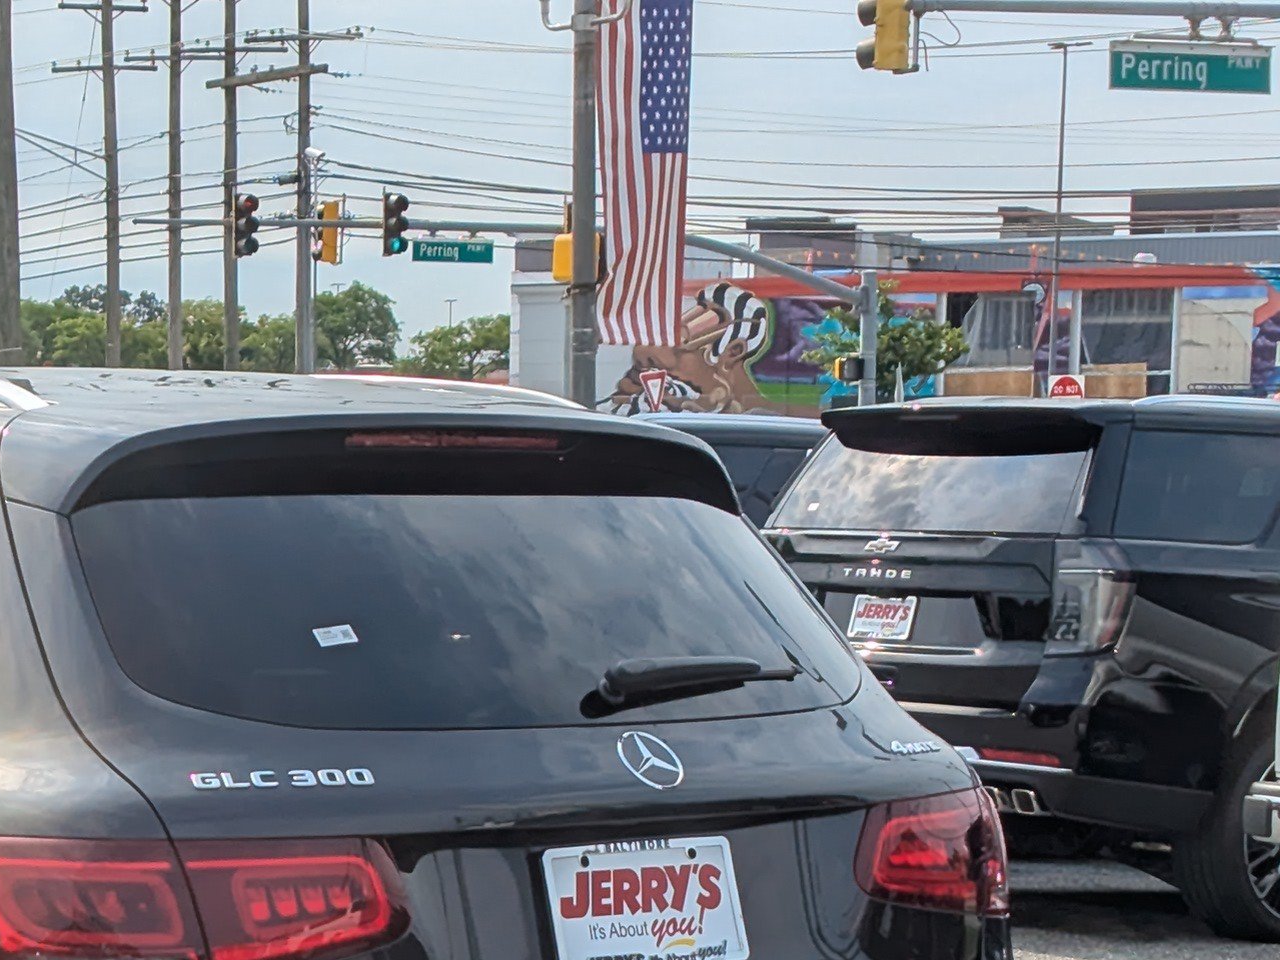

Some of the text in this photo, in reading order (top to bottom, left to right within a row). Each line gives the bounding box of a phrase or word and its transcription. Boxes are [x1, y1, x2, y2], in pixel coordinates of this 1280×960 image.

[1121, 53, 1208, 90] Perring
[420, 243, 459, 261] Perring
[1065, 384, 1079, 394] NOT
[856, 602, 912, 621] JERRY'S
[190, 768, 376, 789] GLC 300
[560, 863, 722, 919] JERRY'S
[588, 923, 607, 940] It's
[609, 922, 650, 940] About
